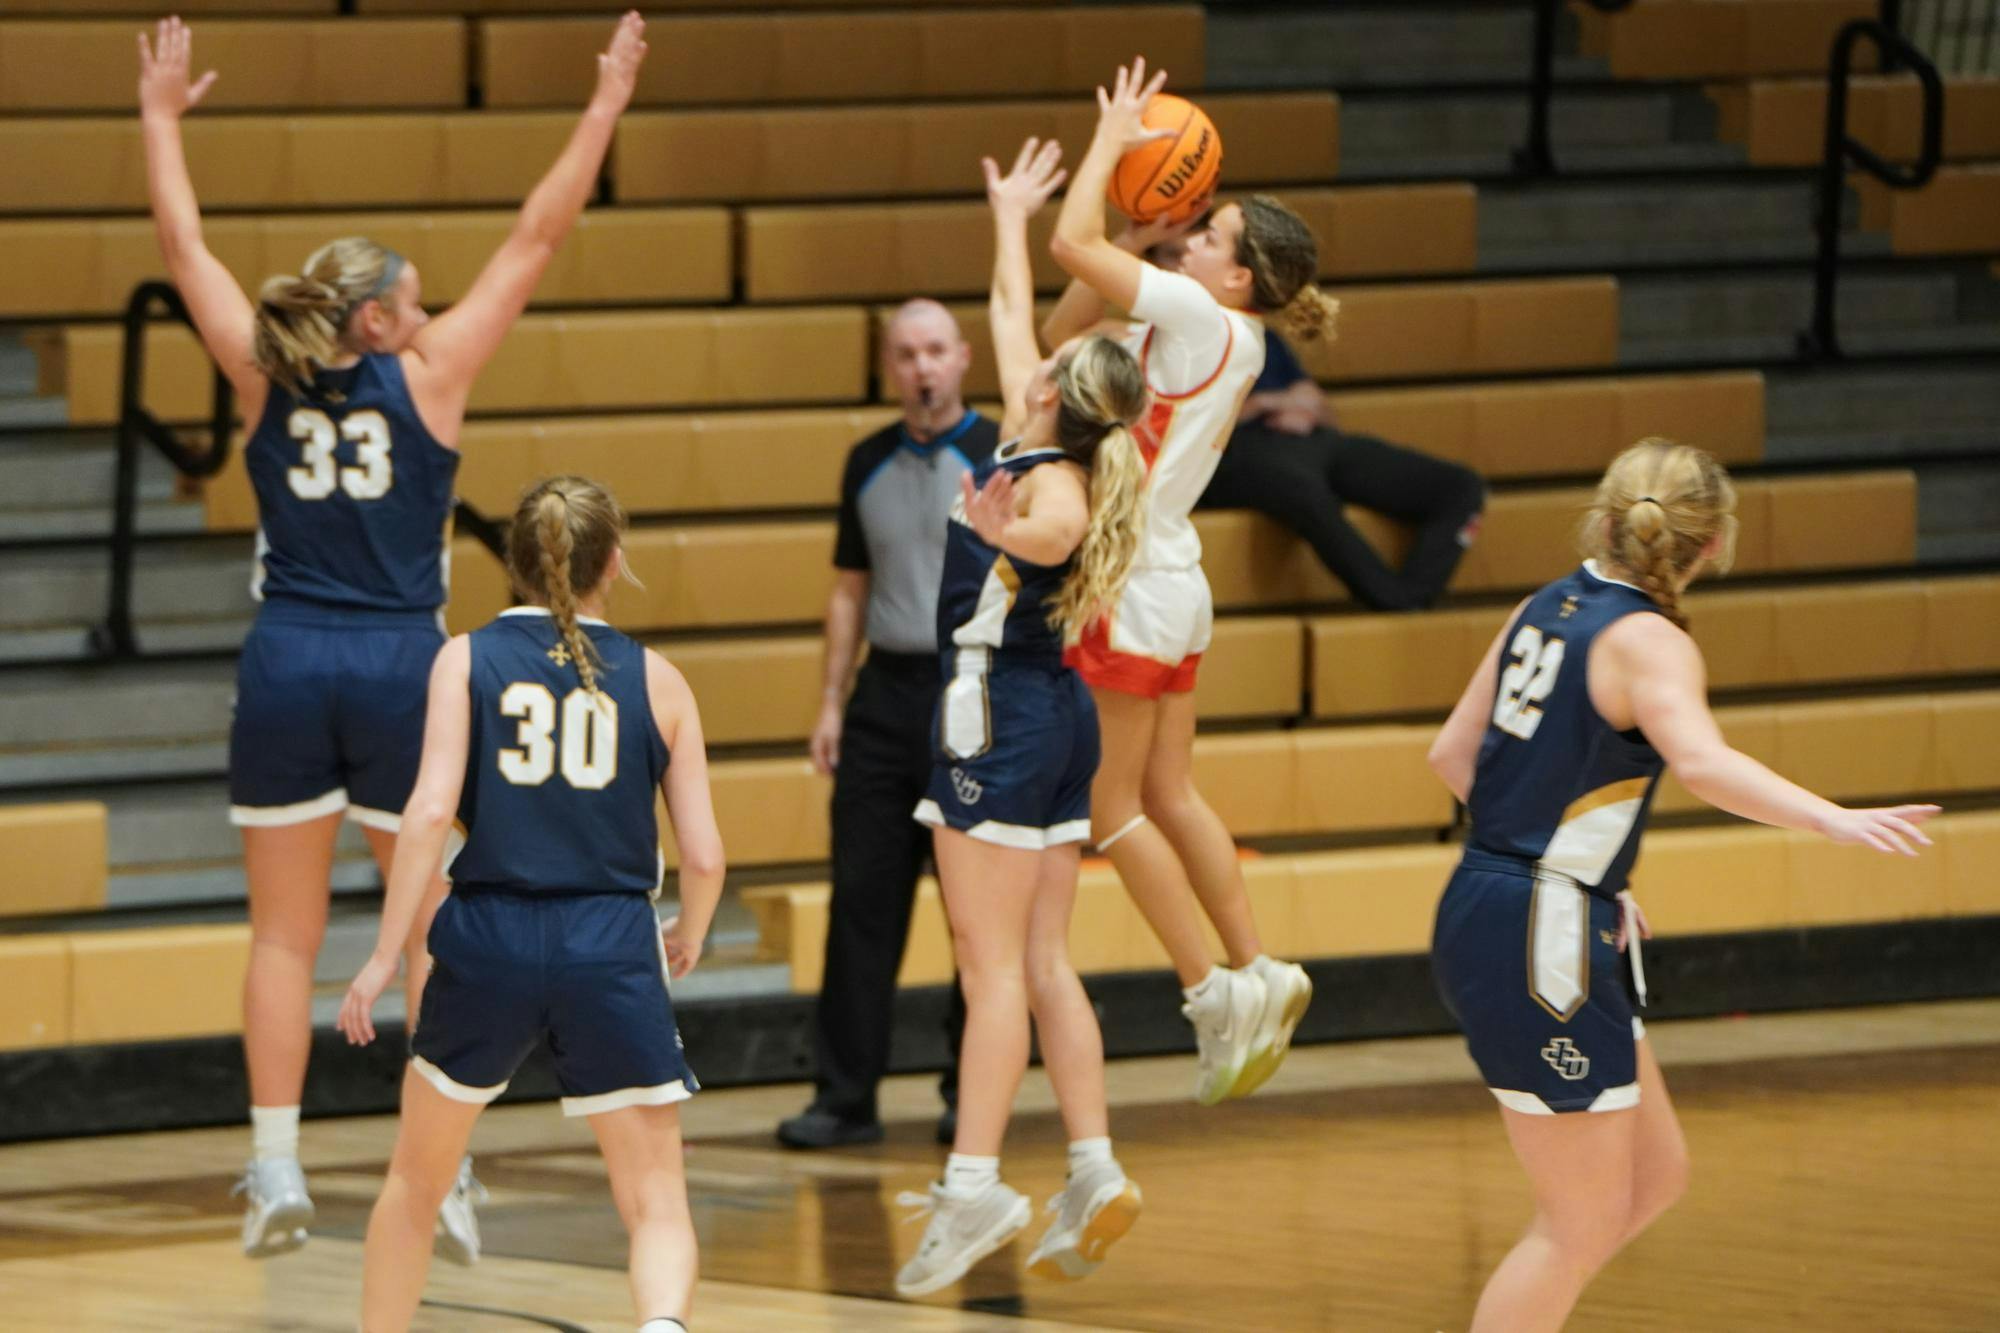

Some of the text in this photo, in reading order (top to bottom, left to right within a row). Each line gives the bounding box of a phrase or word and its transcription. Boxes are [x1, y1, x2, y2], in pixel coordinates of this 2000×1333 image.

[1157, 128, 1210, 198] Wilson
[287, 407, 392, 500] 33
[1492, 624, 1566, 741] 22
[498, 681, 619, 790] 30
